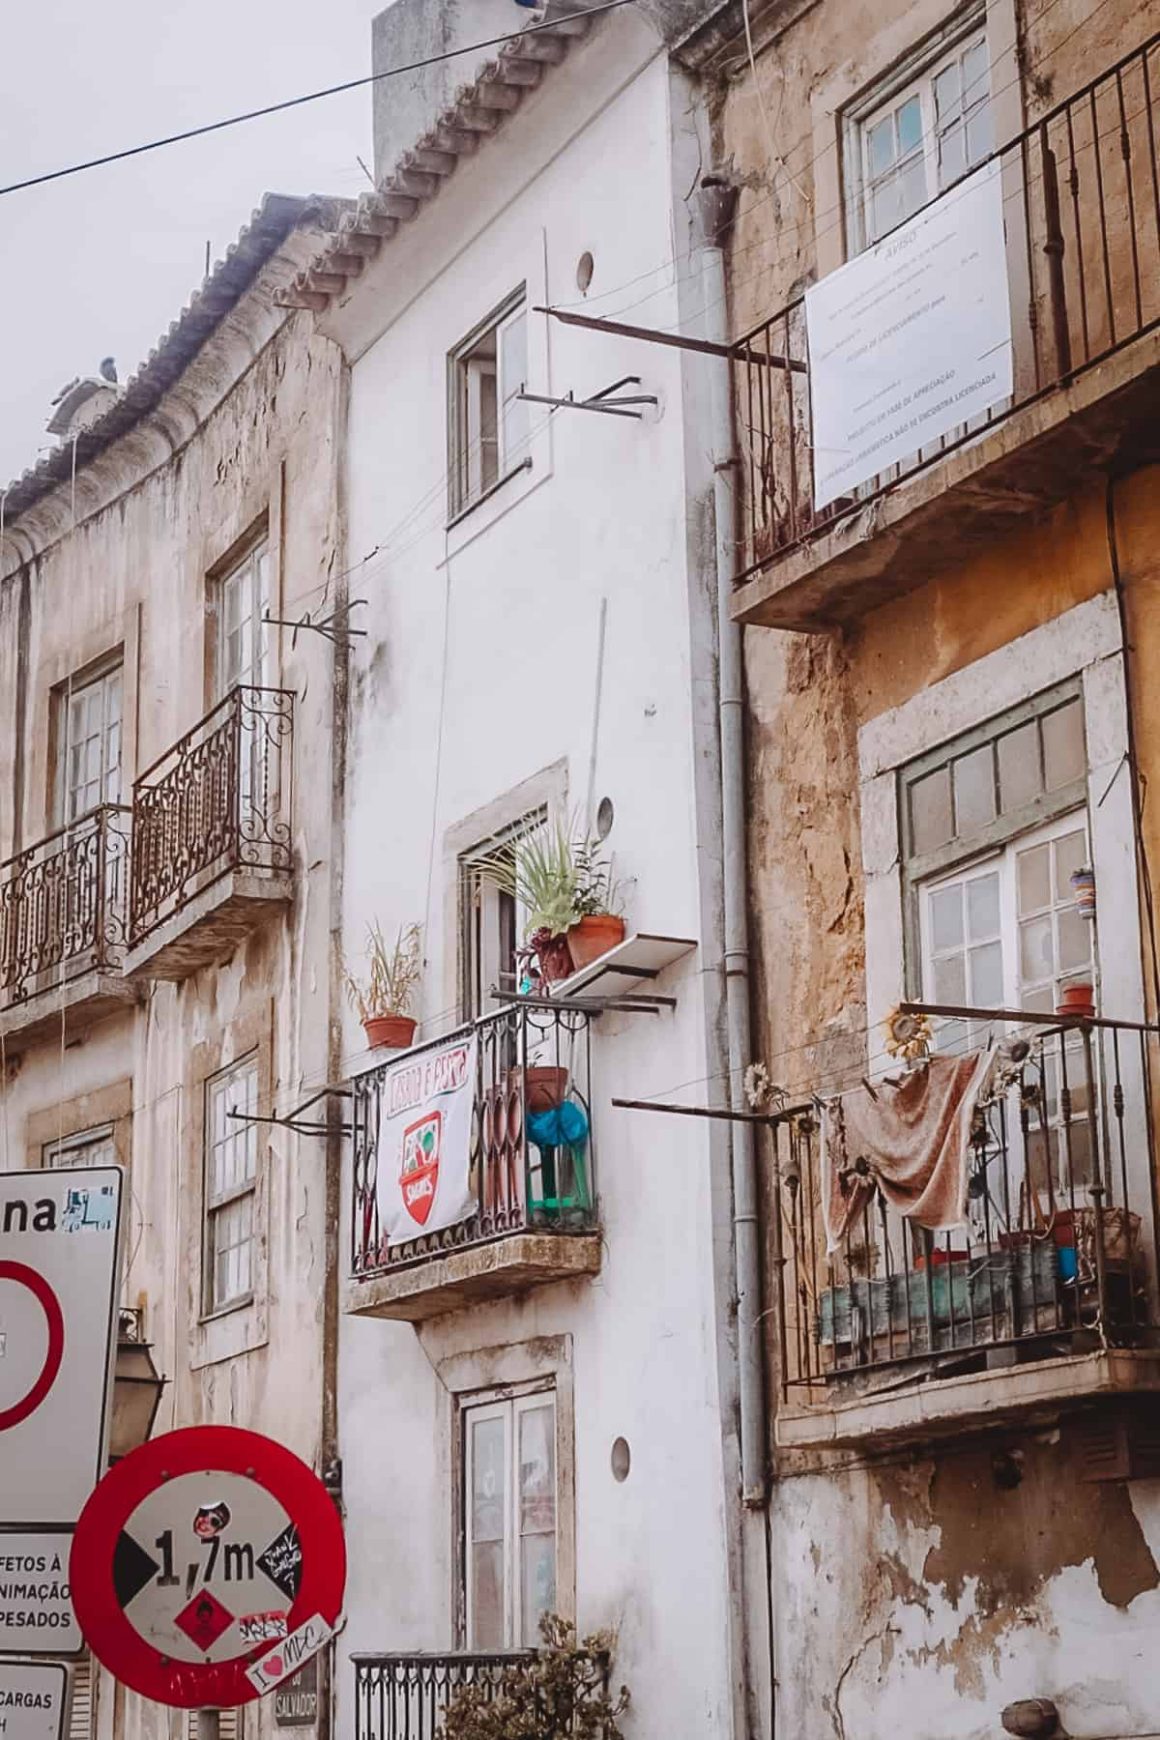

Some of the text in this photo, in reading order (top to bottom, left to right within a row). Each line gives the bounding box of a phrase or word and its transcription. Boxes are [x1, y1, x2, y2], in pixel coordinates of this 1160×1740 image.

[913, 369, 956, 398] APRECIAÇÃO
[954, 372, 997, 401] LICENCIADA
[3, 1198, 57, 1233] na
[51, 1553, 62, 1572] À
[0, 1691, 52, 1709] CARGAS
[276, 1692, 317, 1718] SALVADOR
